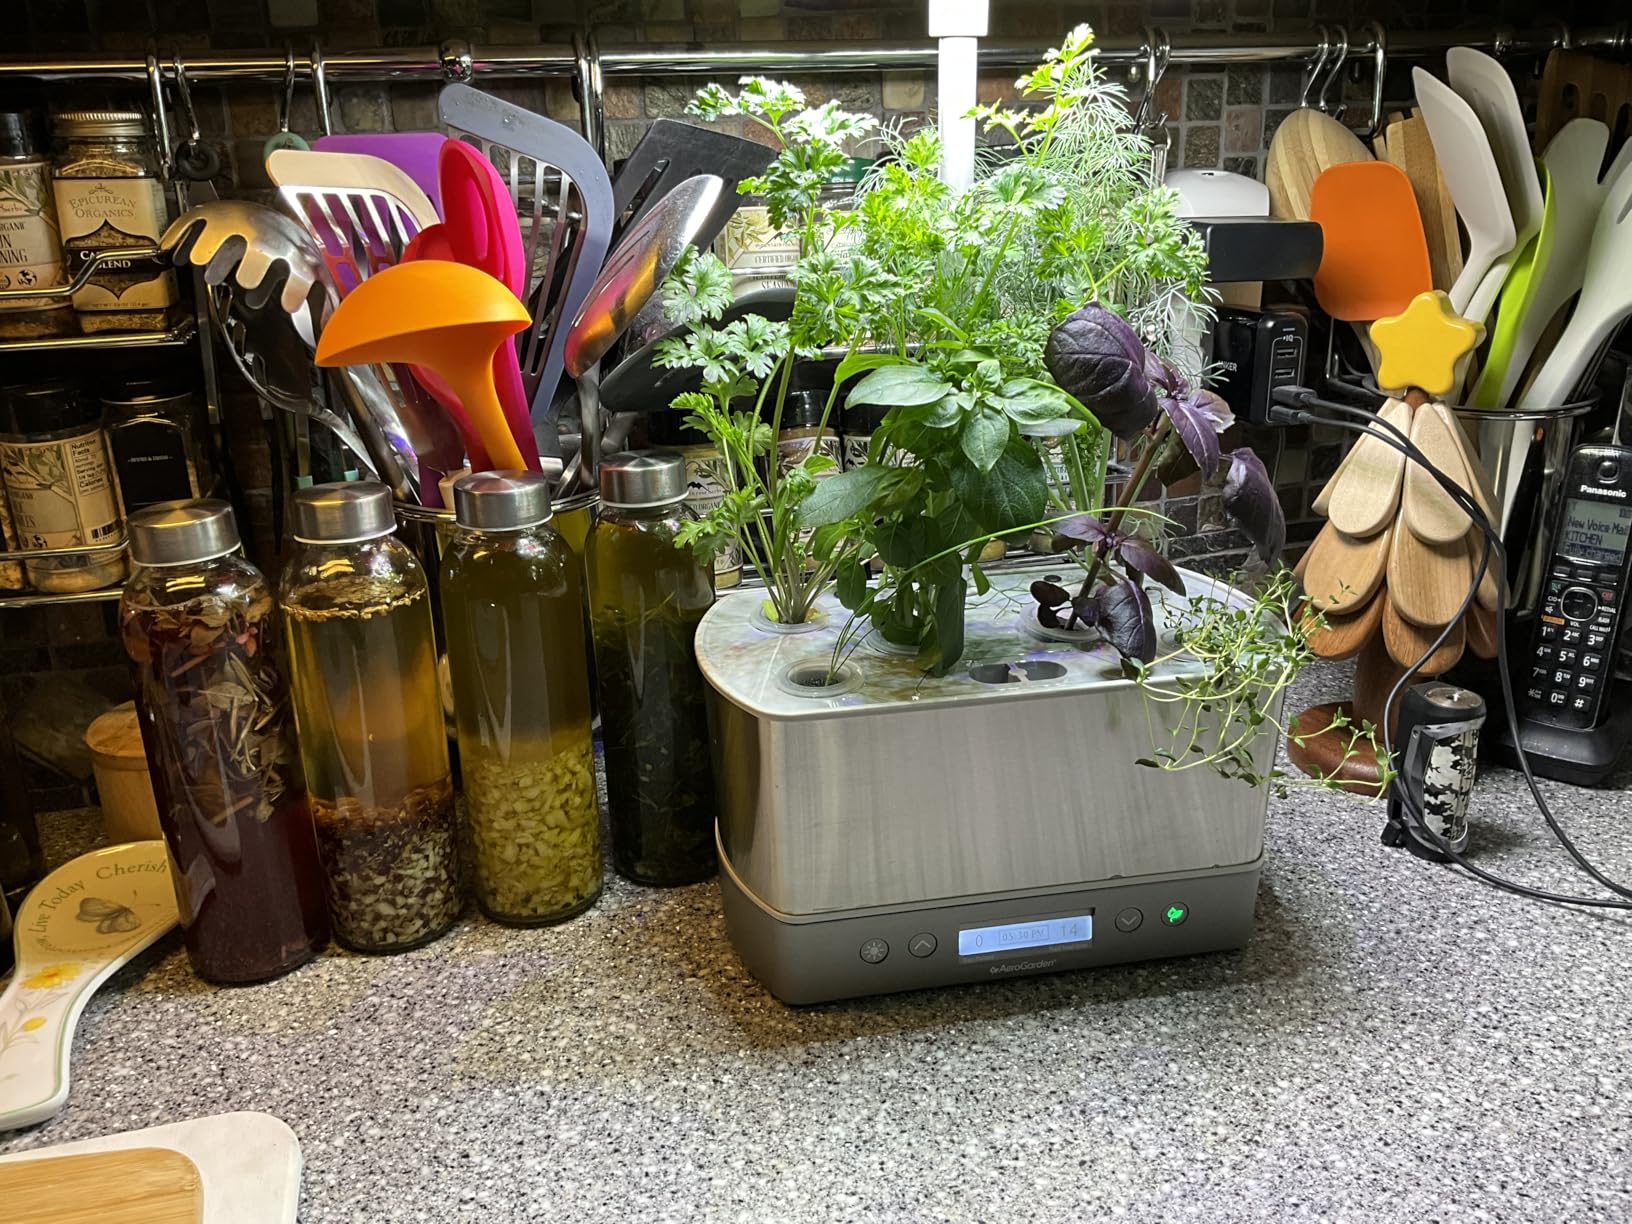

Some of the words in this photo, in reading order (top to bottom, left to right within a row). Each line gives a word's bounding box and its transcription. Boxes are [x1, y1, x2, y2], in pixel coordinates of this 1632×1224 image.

[69, 195, 137, 209] EPICUREAN
[75, 207, 135, 219] ORGANICS
[98, 259, 132, 270] LEND
[1580, 484, 1628, 499] Panasonic
[1587, 518, 1611, 533] Voice
[1564, 530, 1603, 546] KITCHEN
[1542, 625, 1548, 637] 1
[1563, 629, 1572, 641] 2
[1587, 634, 1596, 645] 3
[1536, 646, 1544, 657] 4
[1559, 650, 1568, 662] 5
[1583, 656, 1591, 667] 6
[1532, 666, 1540, 677] 7
[1554, 671, 1563, 682] 8
[1577, 676, 1586, 687] 9
[1550, 692, 1558, 703] 0
[37, 880, 86, 911] Today
[96, 858, 167, 880] Cherish
[1061, 923, 1078, 938] 14
[999, 959, 1056, 974] AeroGarden
